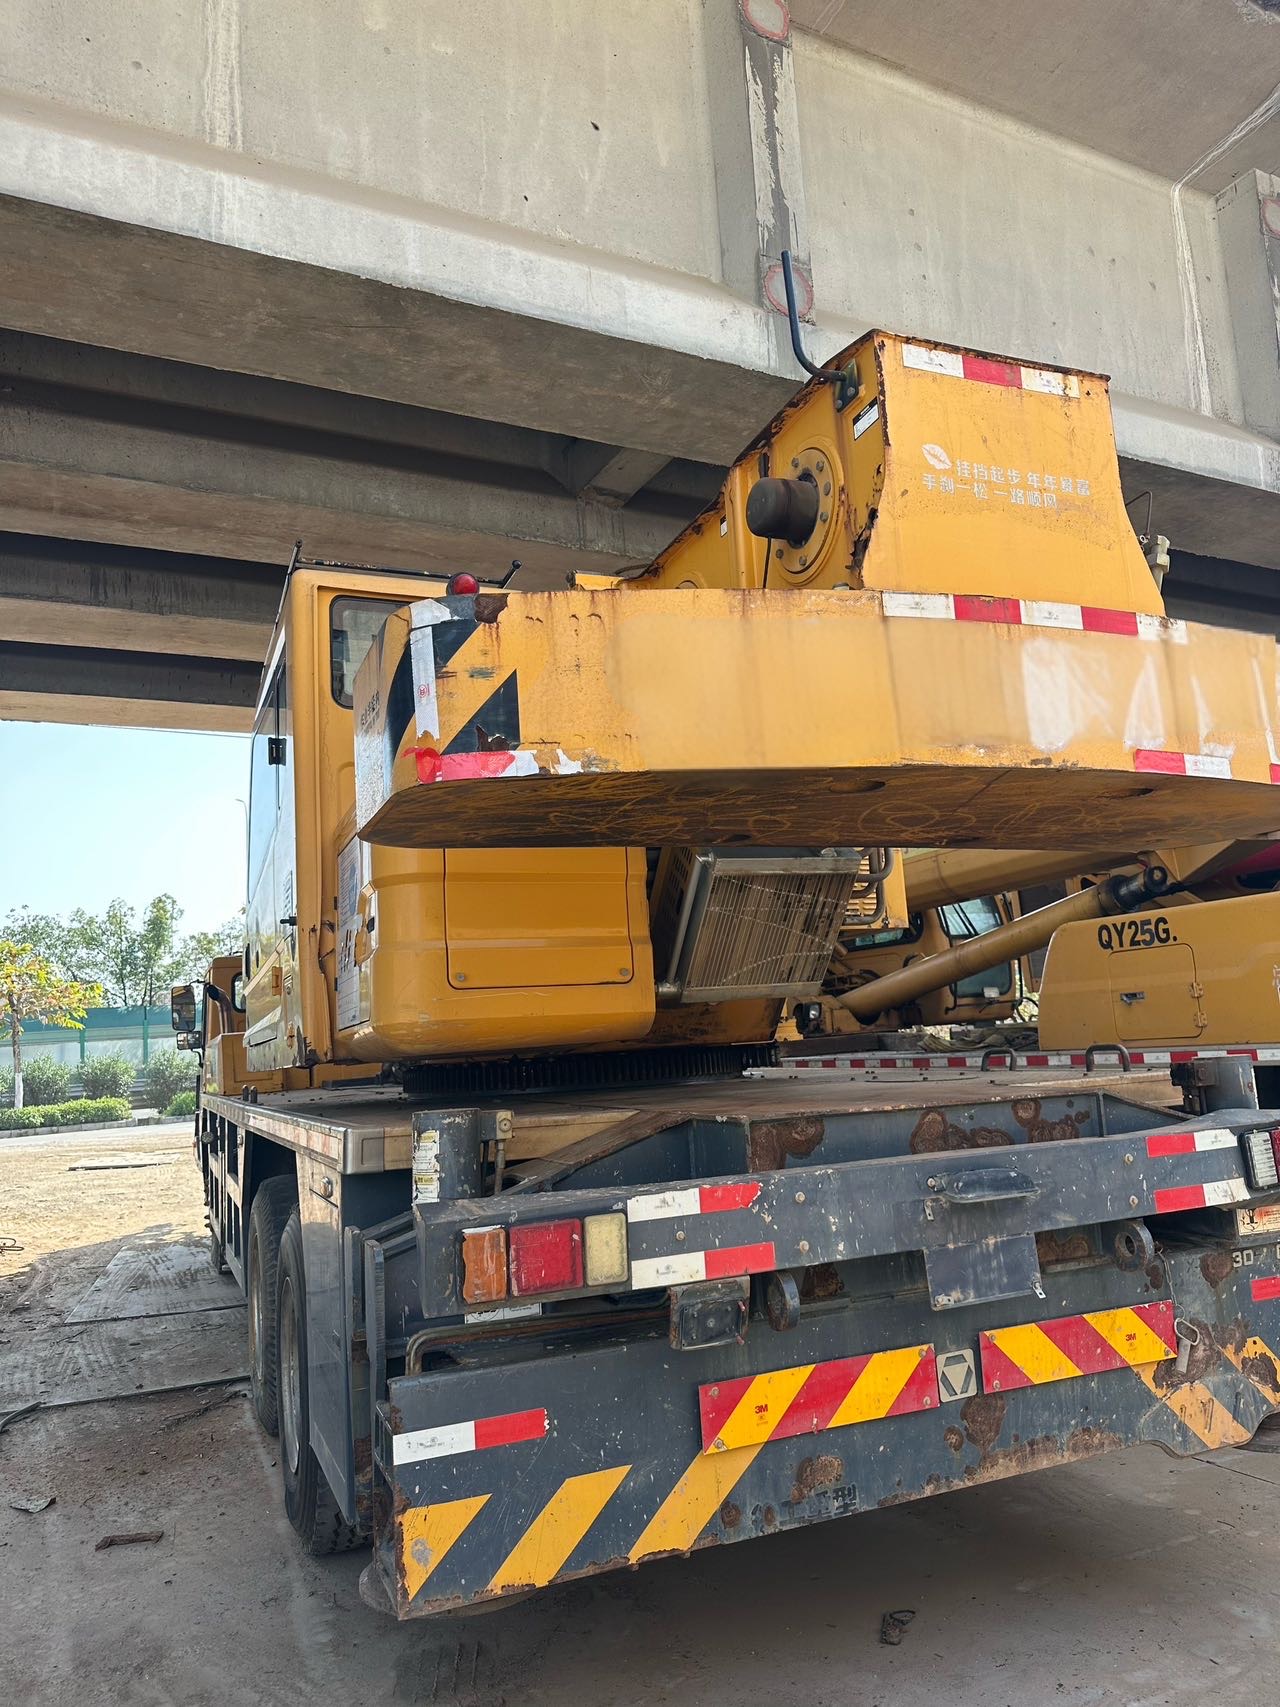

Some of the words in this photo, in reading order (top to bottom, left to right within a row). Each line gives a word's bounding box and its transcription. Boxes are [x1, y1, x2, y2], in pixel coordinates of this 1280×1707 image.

[956, 458, 1022, 485] 挂挡起步
[1027, 471, 1090, 496] 年年暴富
[922, 473, 989, 500] 手刹一松
[994, 488, 1058, 508] 一路顺风
[1125, 1332, 1137, 1342] 3M
[754, 1403, 769, 1414] 3M
